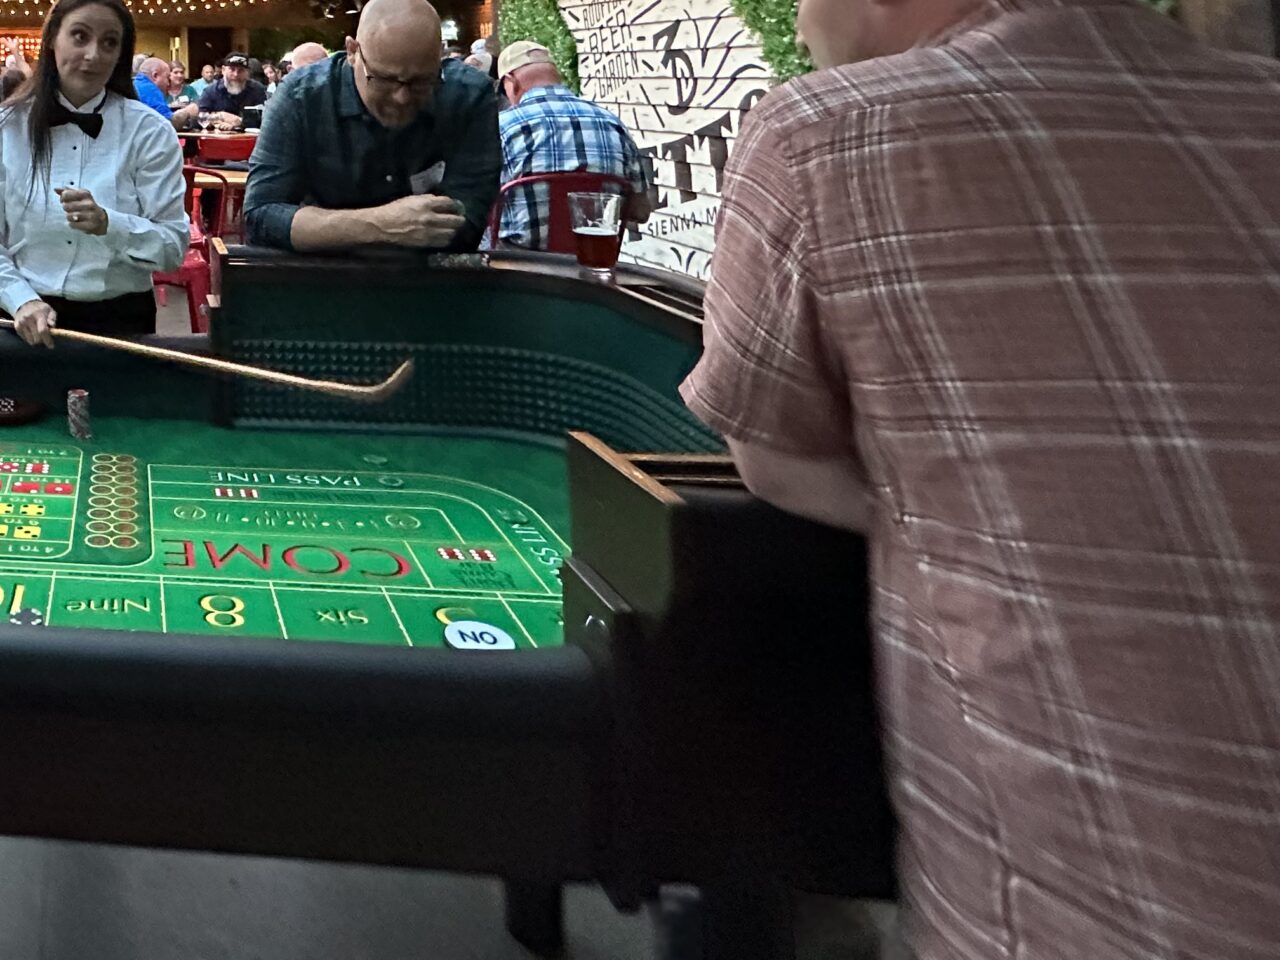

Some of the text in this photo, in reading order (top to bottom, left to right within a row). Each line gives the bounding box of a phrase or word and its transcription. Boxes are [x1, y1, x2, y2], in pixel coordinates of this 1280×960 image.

[589, 8, 632, 65] BEER
[594, 43, 639, 99] GARDEN
[647, 211, 703, 237] SIENNA
[207, 471, 361, 487] PASS LINE
[161, 539, 412, 580] COME
[66, 597, 150, 615] Nine
[199, 594, 245, 628] 8
[315, 608, 369, 626] Six
[457, 629, 499, 646] ON
